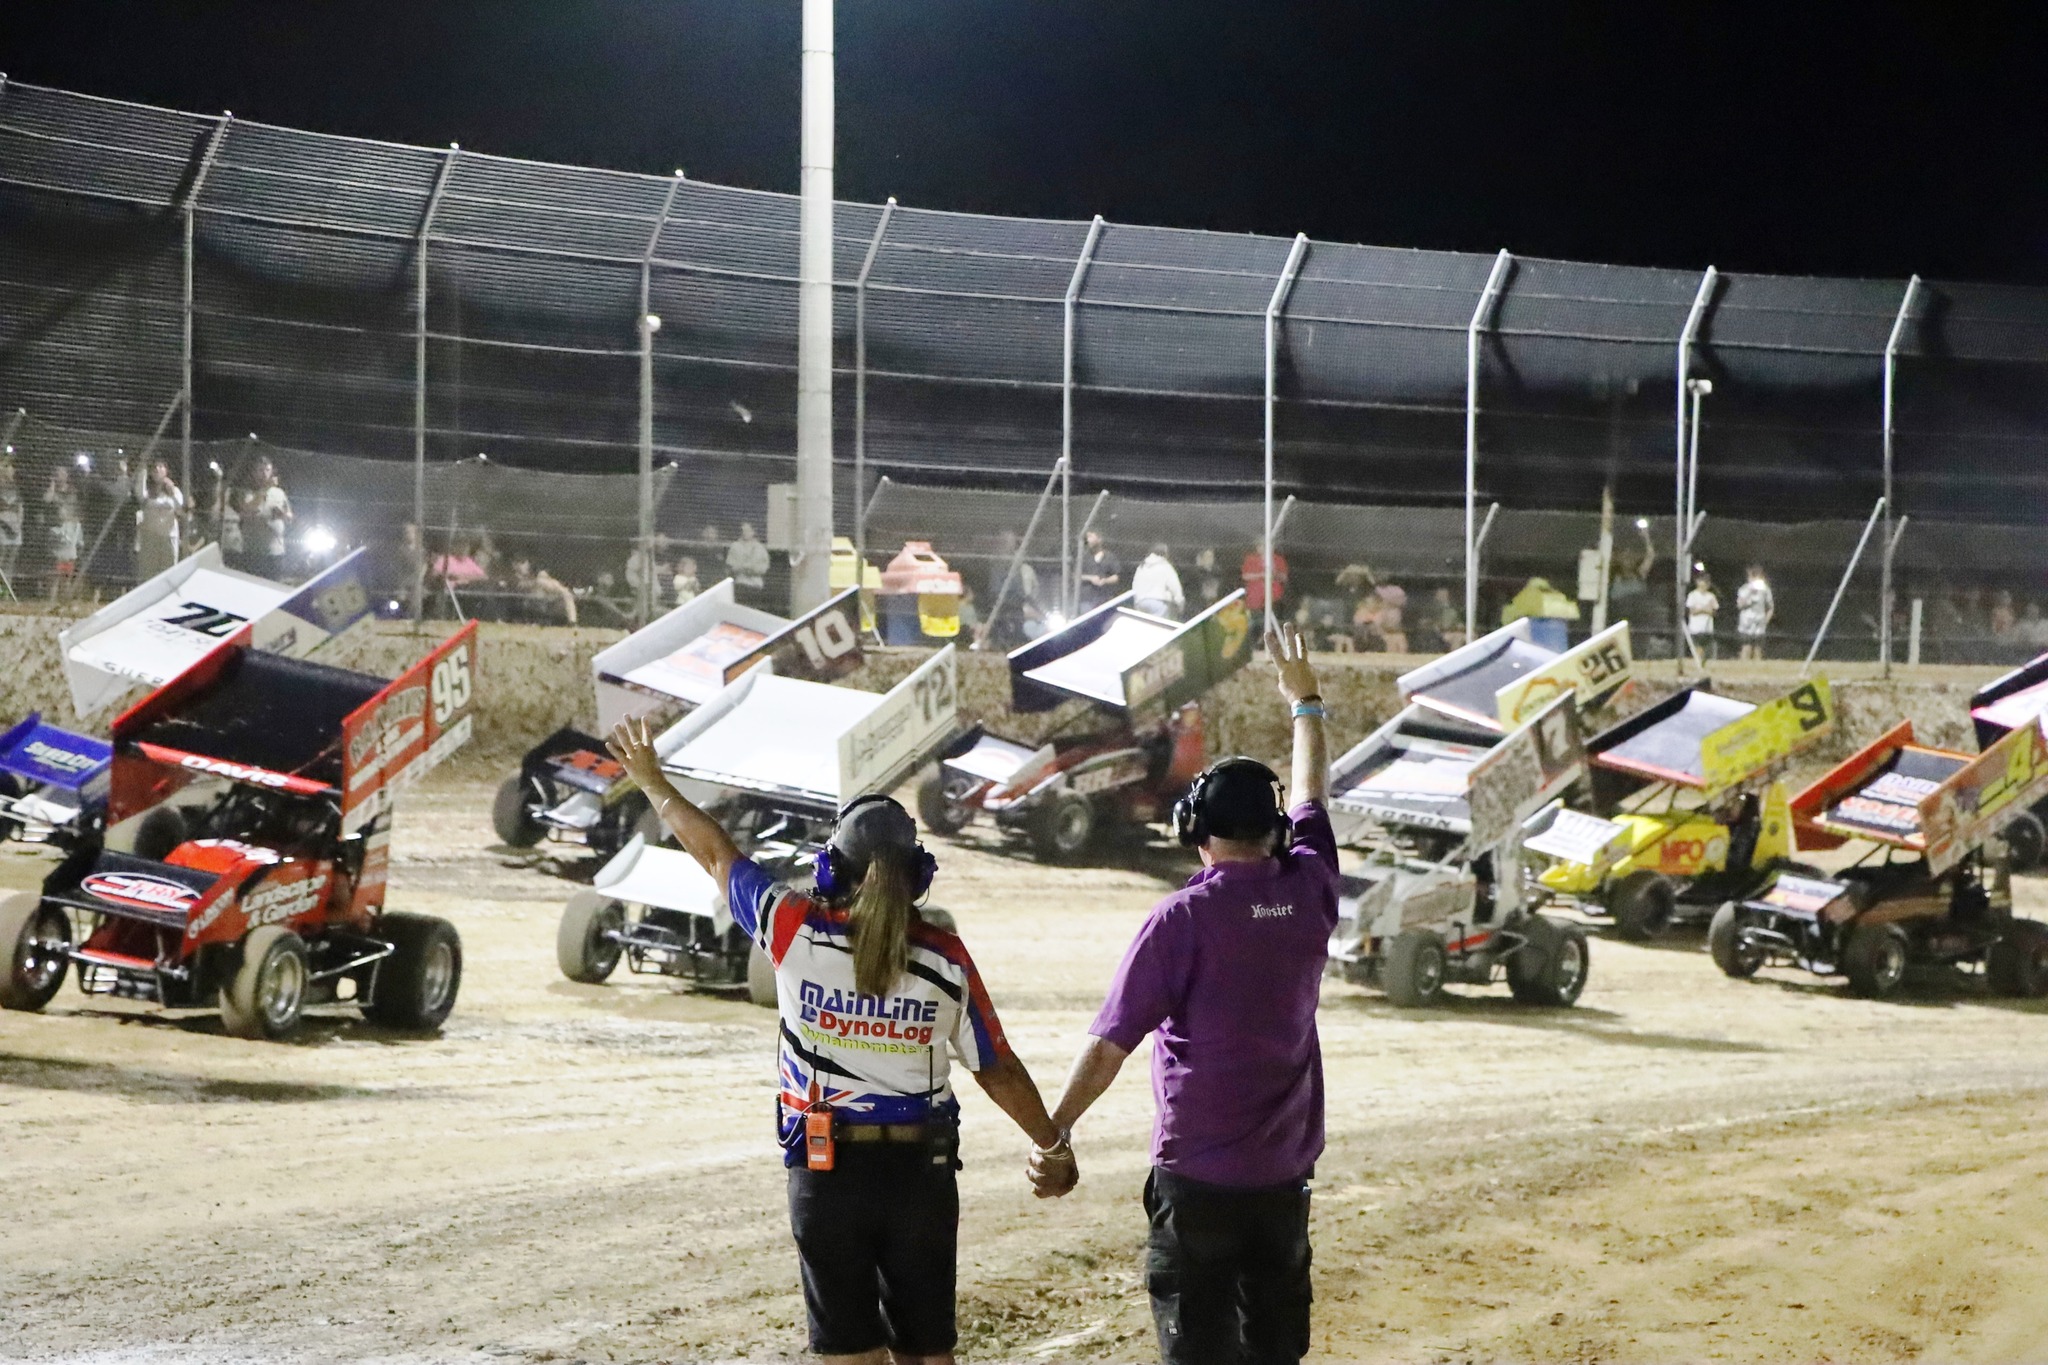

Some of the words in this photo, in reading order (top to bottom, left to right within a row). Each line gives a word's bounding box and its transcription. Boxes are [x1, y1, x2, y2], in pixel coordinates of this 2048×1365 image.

[796, 609, 855, 670] 10
[432, 645, 471, 724] 95
[914, 664, 953, 723] 72
[1789, 683, 1826, 732] 9
[181, 755, 289, 787] DAVIS
[1251, 903, 1293, 918] Hoosier
[819, 1010, 933, 1045] DynoLog
